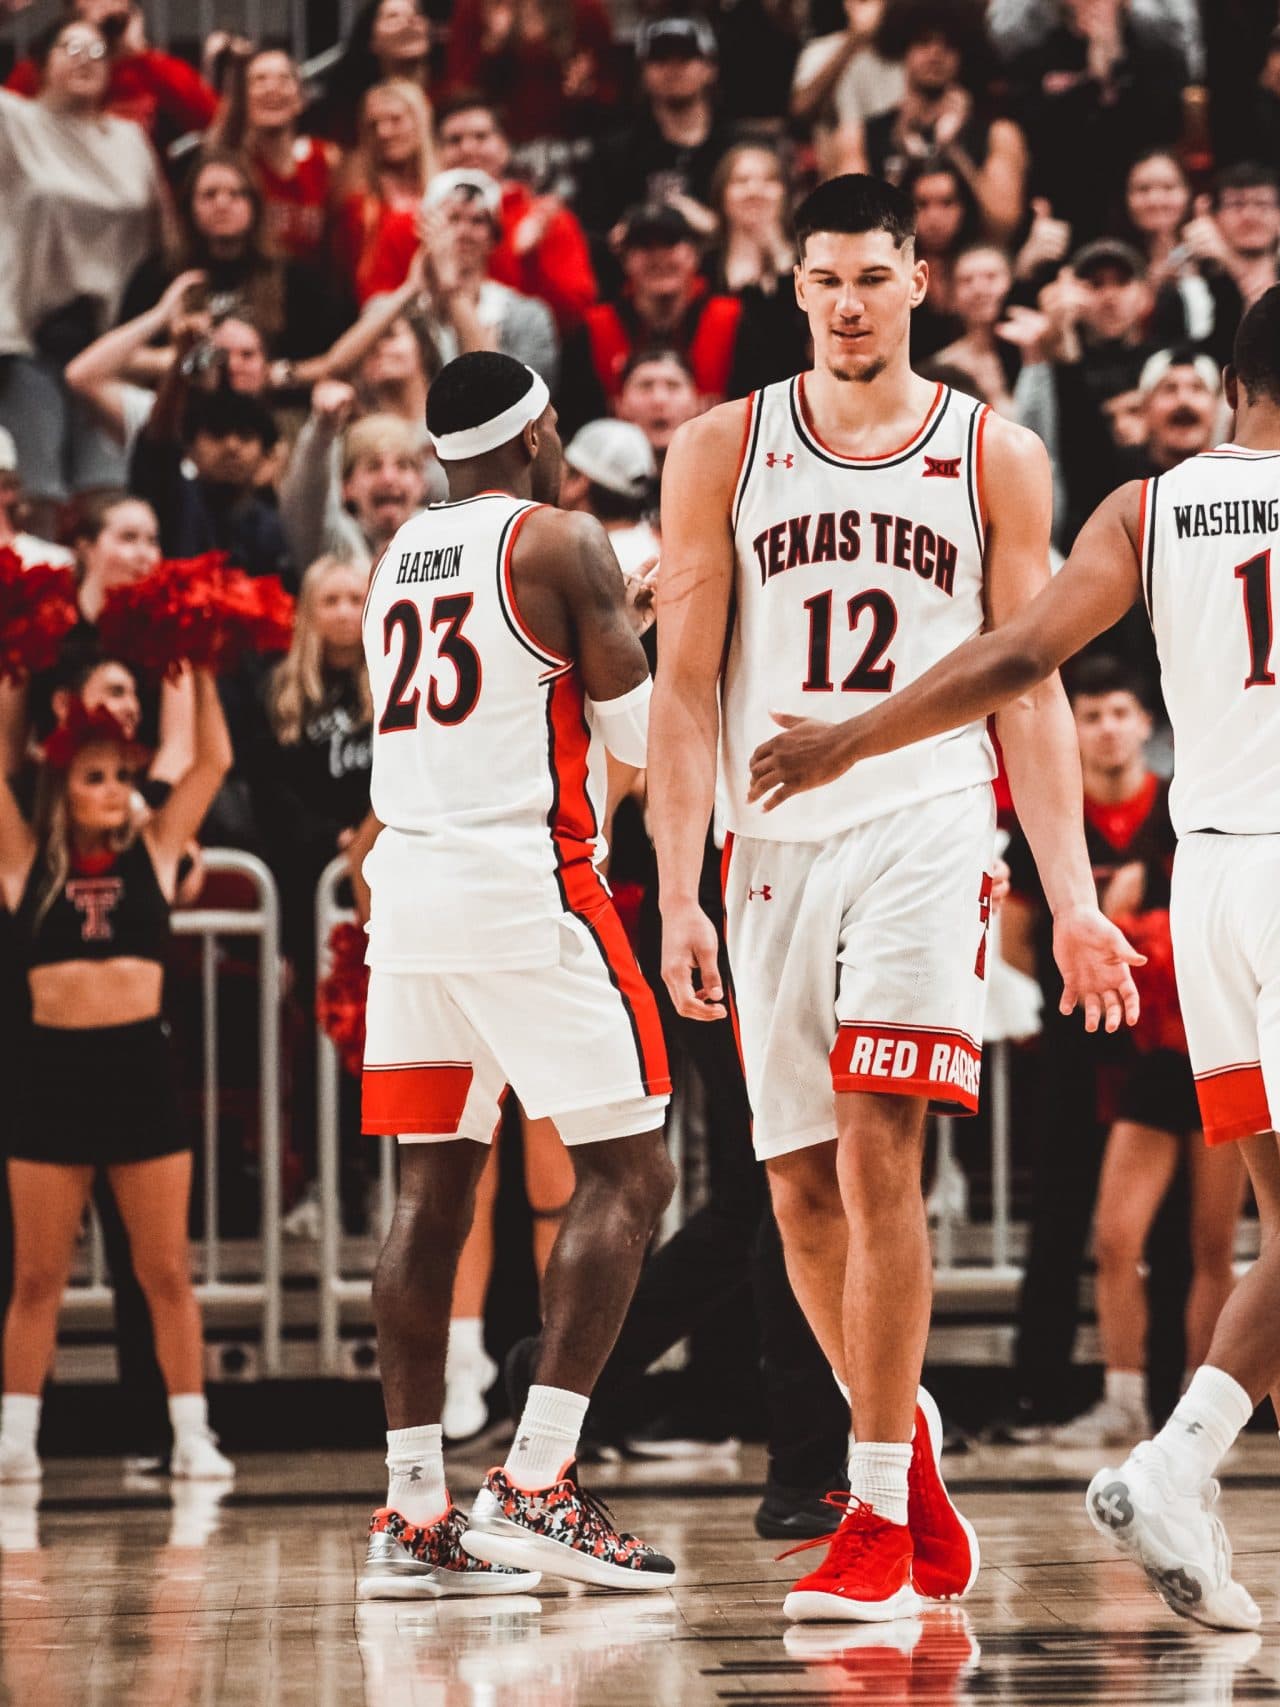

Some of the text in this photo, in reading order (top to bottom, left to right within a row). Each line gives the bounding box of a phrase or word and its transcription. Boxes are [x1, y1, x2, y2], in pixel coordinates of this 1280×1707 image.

[396, 544, 464, 584] HARMON
[752, 509, 958, 598] TEXAS TECH
[379, 591, 482, 734] 23
[802, 588, 898, 692] 12
[1234, 548, 1276, 690] 1
[849, 1035, 918, 1078] RED
